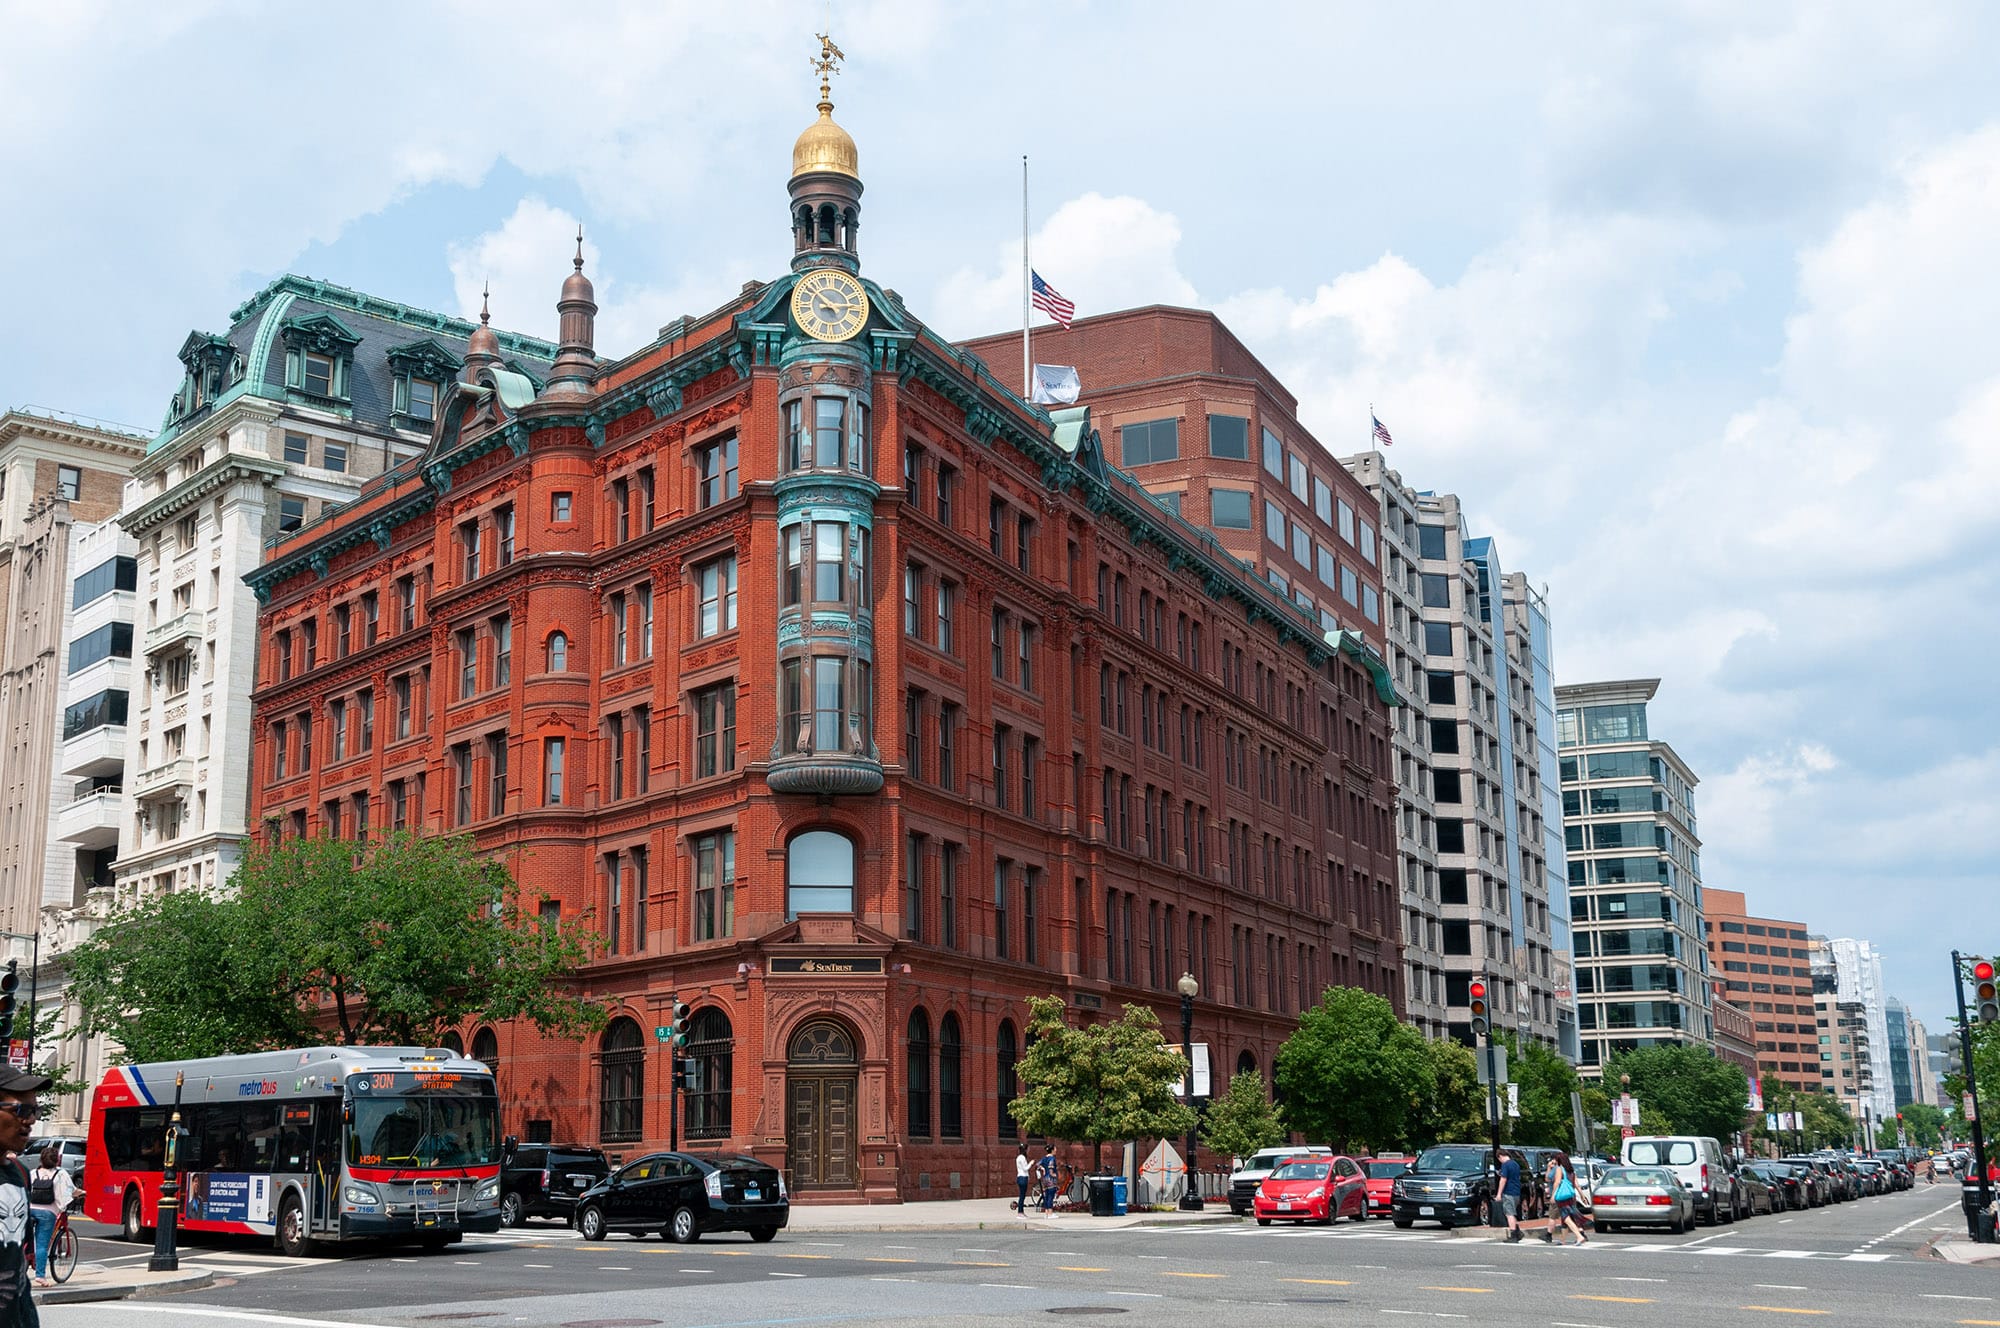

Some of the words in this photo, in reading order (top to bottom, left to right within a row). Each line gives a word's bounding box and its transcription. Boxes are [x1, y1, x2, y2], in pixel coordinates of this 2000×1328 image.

[372, 1073, 395, 1089] 30N
[422, 1081, 454, 1089] STATION
[239, 1079, 277, 1096] metrobus
[357, 1205, 375, 1214] 7166
